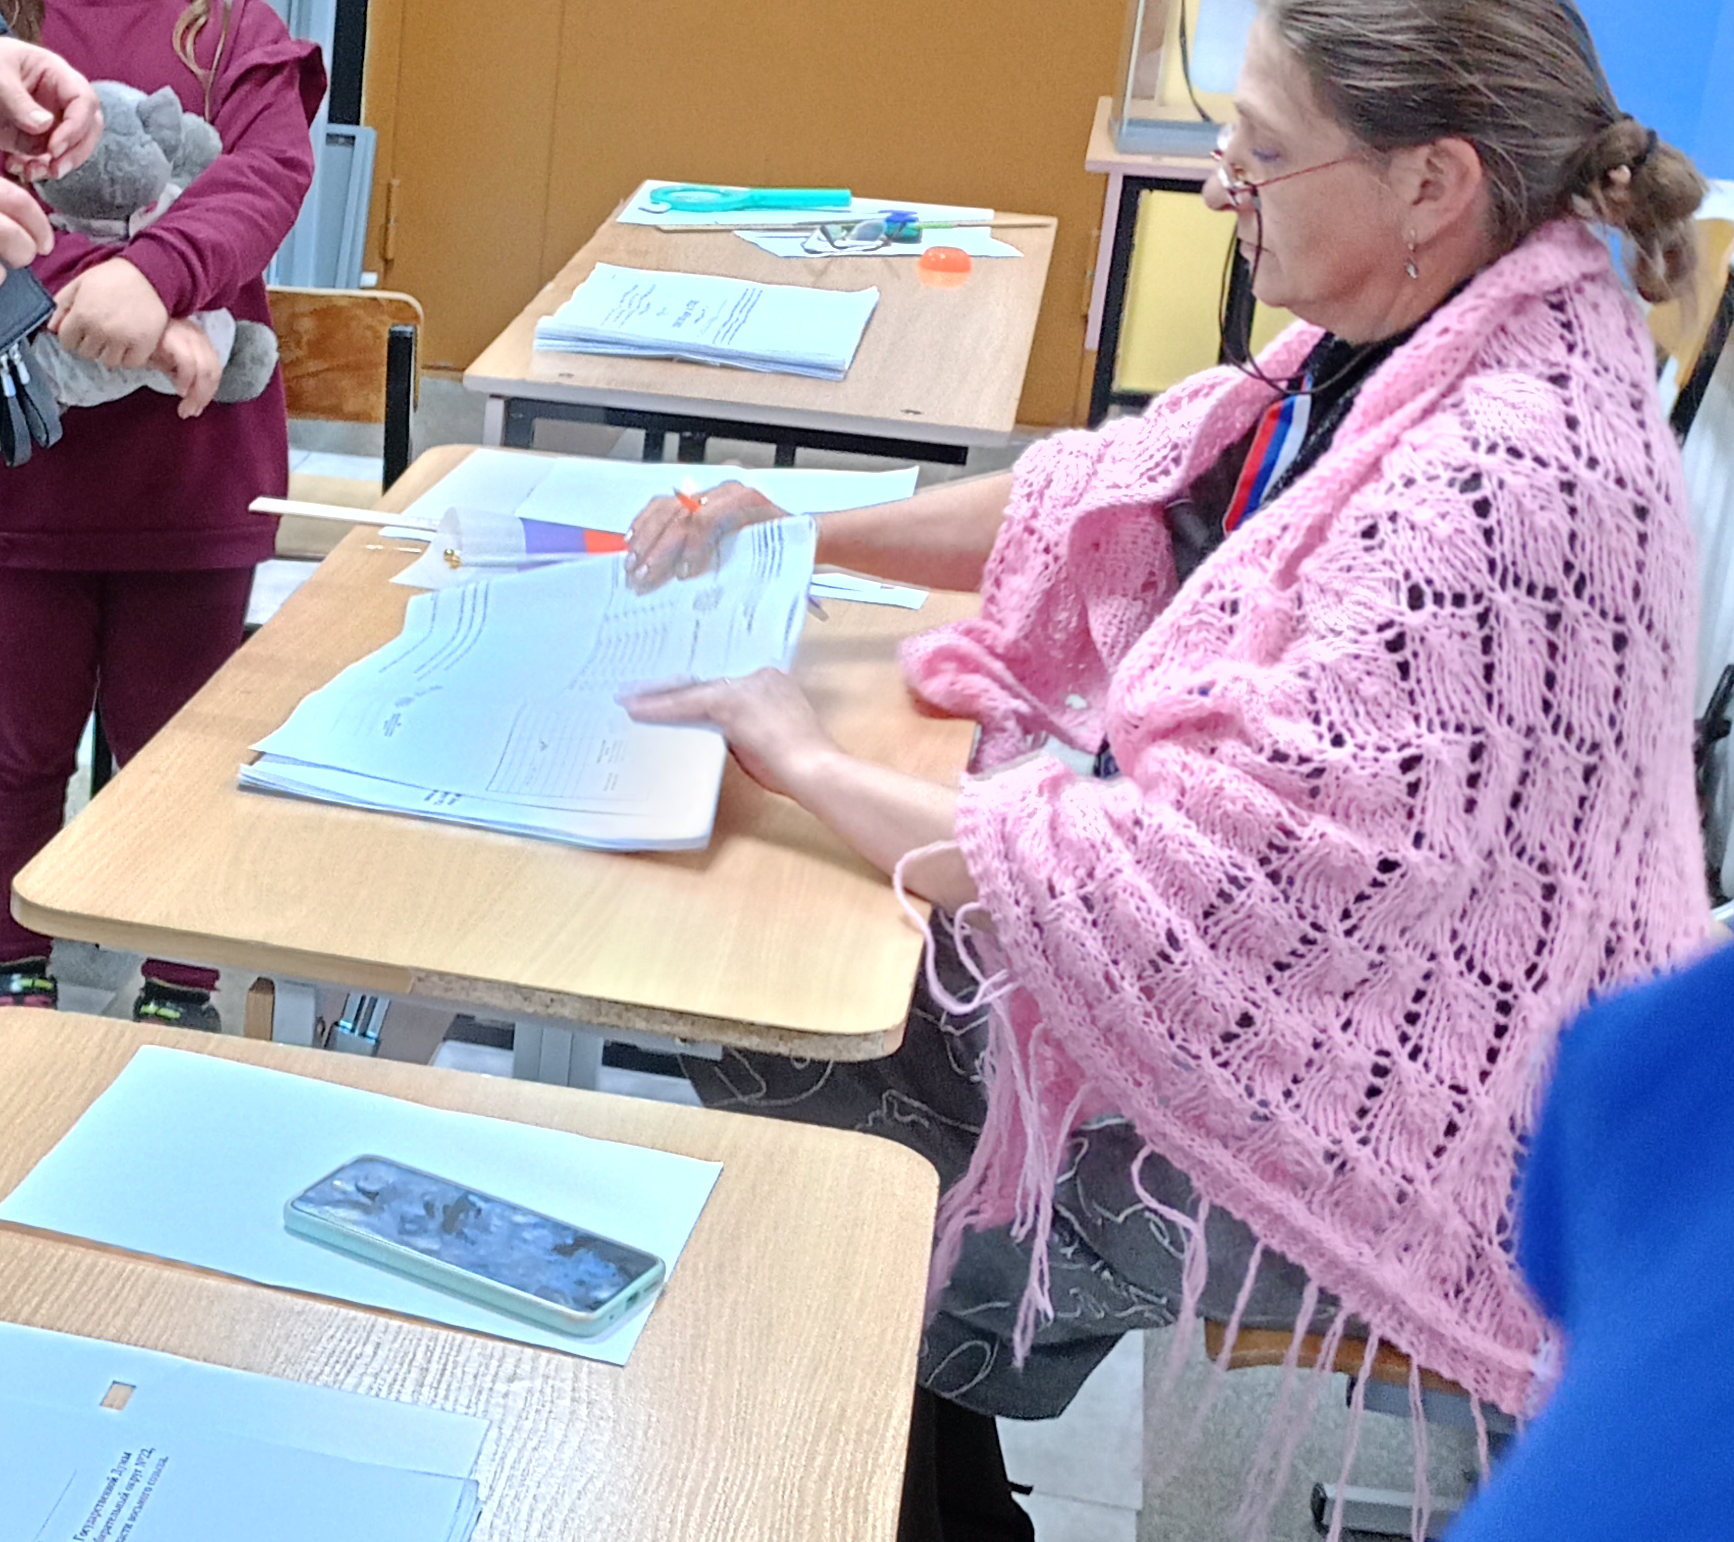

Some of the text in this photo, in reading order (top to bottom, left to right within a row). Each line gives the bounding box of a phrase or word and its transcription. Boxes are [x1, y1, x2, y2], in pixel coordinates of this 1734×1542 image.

[110, 1451, 132, 1477] Думы
[125, 1468, 143, 1492] округ
[127, 1486, 152, 1524] восьмого
